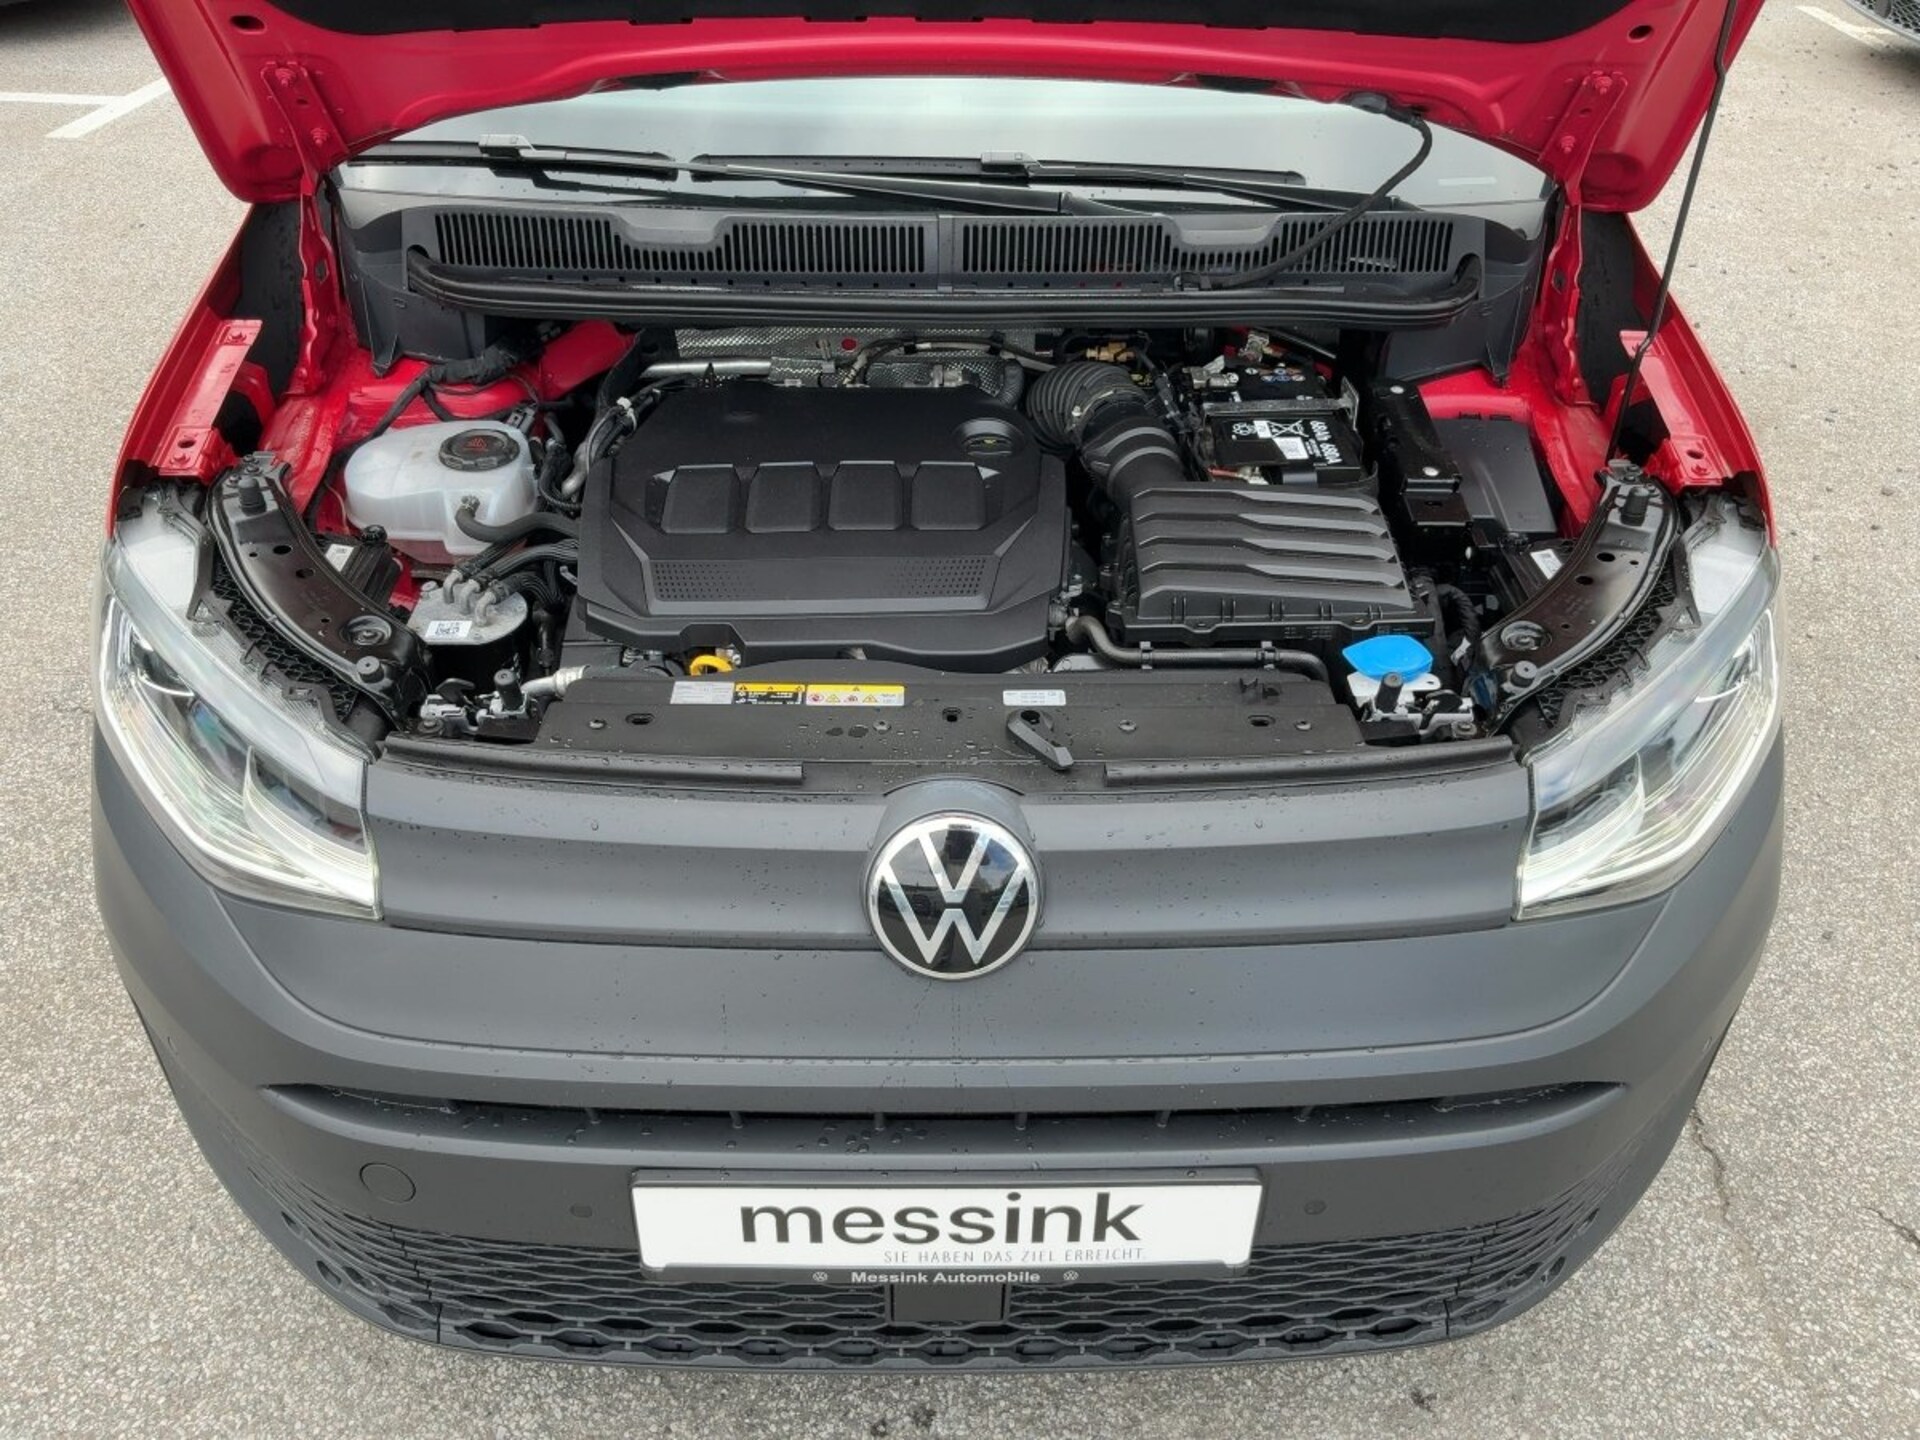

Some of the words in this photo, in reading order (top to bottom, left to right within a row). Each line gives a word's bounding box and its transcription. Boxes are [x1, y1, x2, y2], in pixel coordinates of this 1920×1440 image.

[740, 1192, 1145, 1245] messink
[884, 1251, 908, 1264] SIE
[919, 1250, 975, 1263] HABEN
[983, 1250, 1013, 1263] DAS
[1021, 1249, 1054, 1262] ZIEL
[850, 1271, 929, 1283] Messink
[933, 1271, 1041, 1283] Automobile
